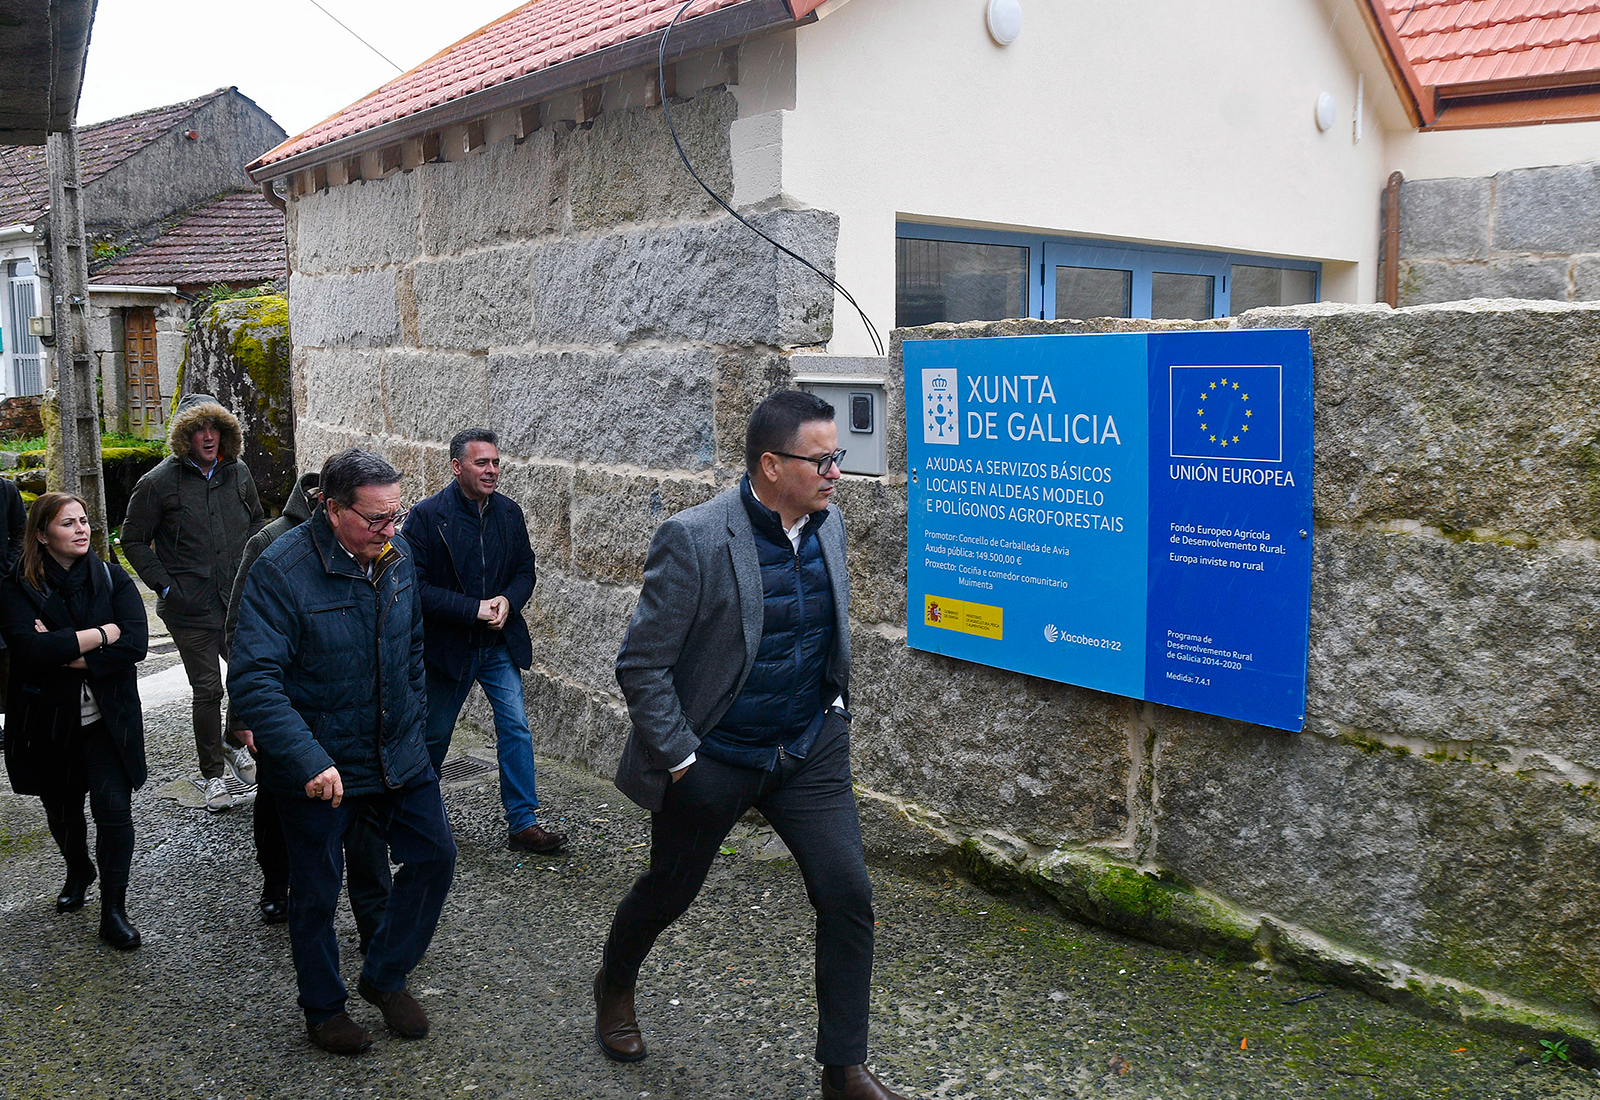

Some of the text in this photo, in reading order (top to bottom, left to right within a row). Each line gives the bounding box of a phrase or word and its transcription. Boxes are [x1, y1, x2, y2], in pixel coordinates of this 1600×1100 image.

[967, 375, 1057, 404] XUNTA
[967, 411, 1122, 446] DE GALICIA
[925, 456, 1112, 483] AXUDAS A SERVIZOS BÁSICOS
[1169, 463, 1296, 487] UNIÓN EUROPEA
[926, 478, 1105, 507] LOCAIS EN ALDEAS MODELO
[926, 497, 1125, 533] E POLÍGONOS AGROFORESTAIS
[924, 529, 1070, 556] Promotor: Concello de Carballeda de Avia
[1170, 522, 1271, 542] Fondo Europeo Agrícola
[924, 543, 1023, 566] Axuda pública: 149.500,00 €
[1169, 534, 1286, 555] de Desenvolvemento Rural:
[1169, 552, 1265, 572] Europa inviste no rural
[924, 558, 1068, 589] Proxecto: Cociña e comedor comunitario
[958, 576, 994, 590] Muimenta
[1060, 630, 1100, 648] Xacobeo
[1167, 629, 1213, 644] Programa de
[1166, 650, 1242, 670] de Galicia 2014-2020
[1167, 640, 1253, 662] Desenvolvemento Rural
[1166, 671, 1211, 686] Medida: 7.4.1
